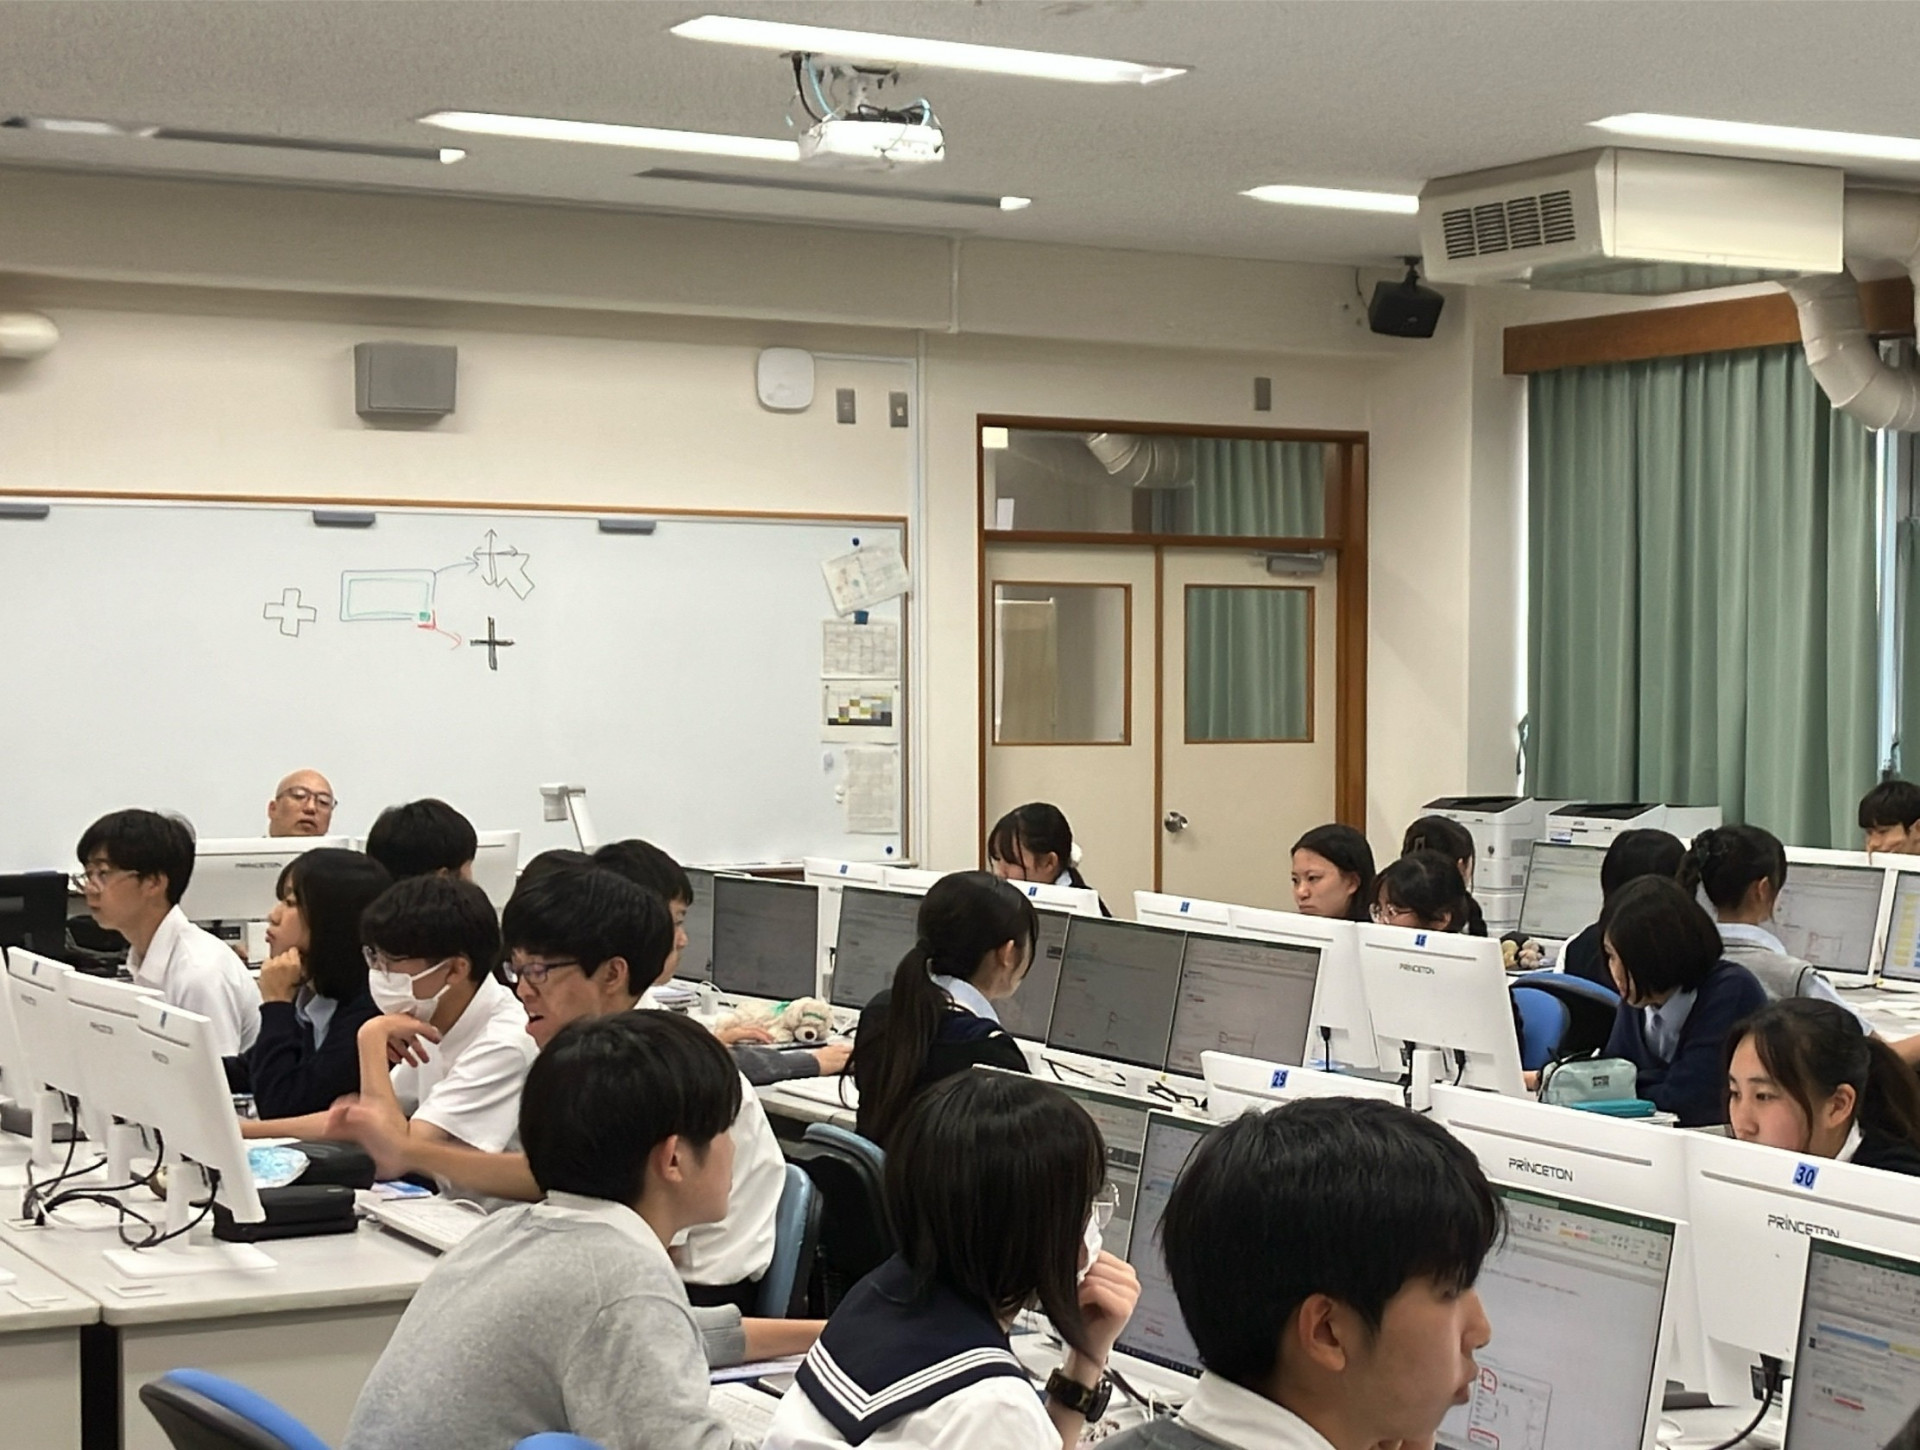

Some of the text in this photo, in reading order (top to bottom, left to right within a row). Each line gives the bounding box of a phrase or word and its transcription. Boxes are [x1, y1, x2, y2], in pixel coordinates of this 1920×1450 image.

[1272, 1071, 1287, 1087] 29
[1508, 1157, 1573, 1182] PRINCETON
[1795, 1166, 1816, 1187] 30
